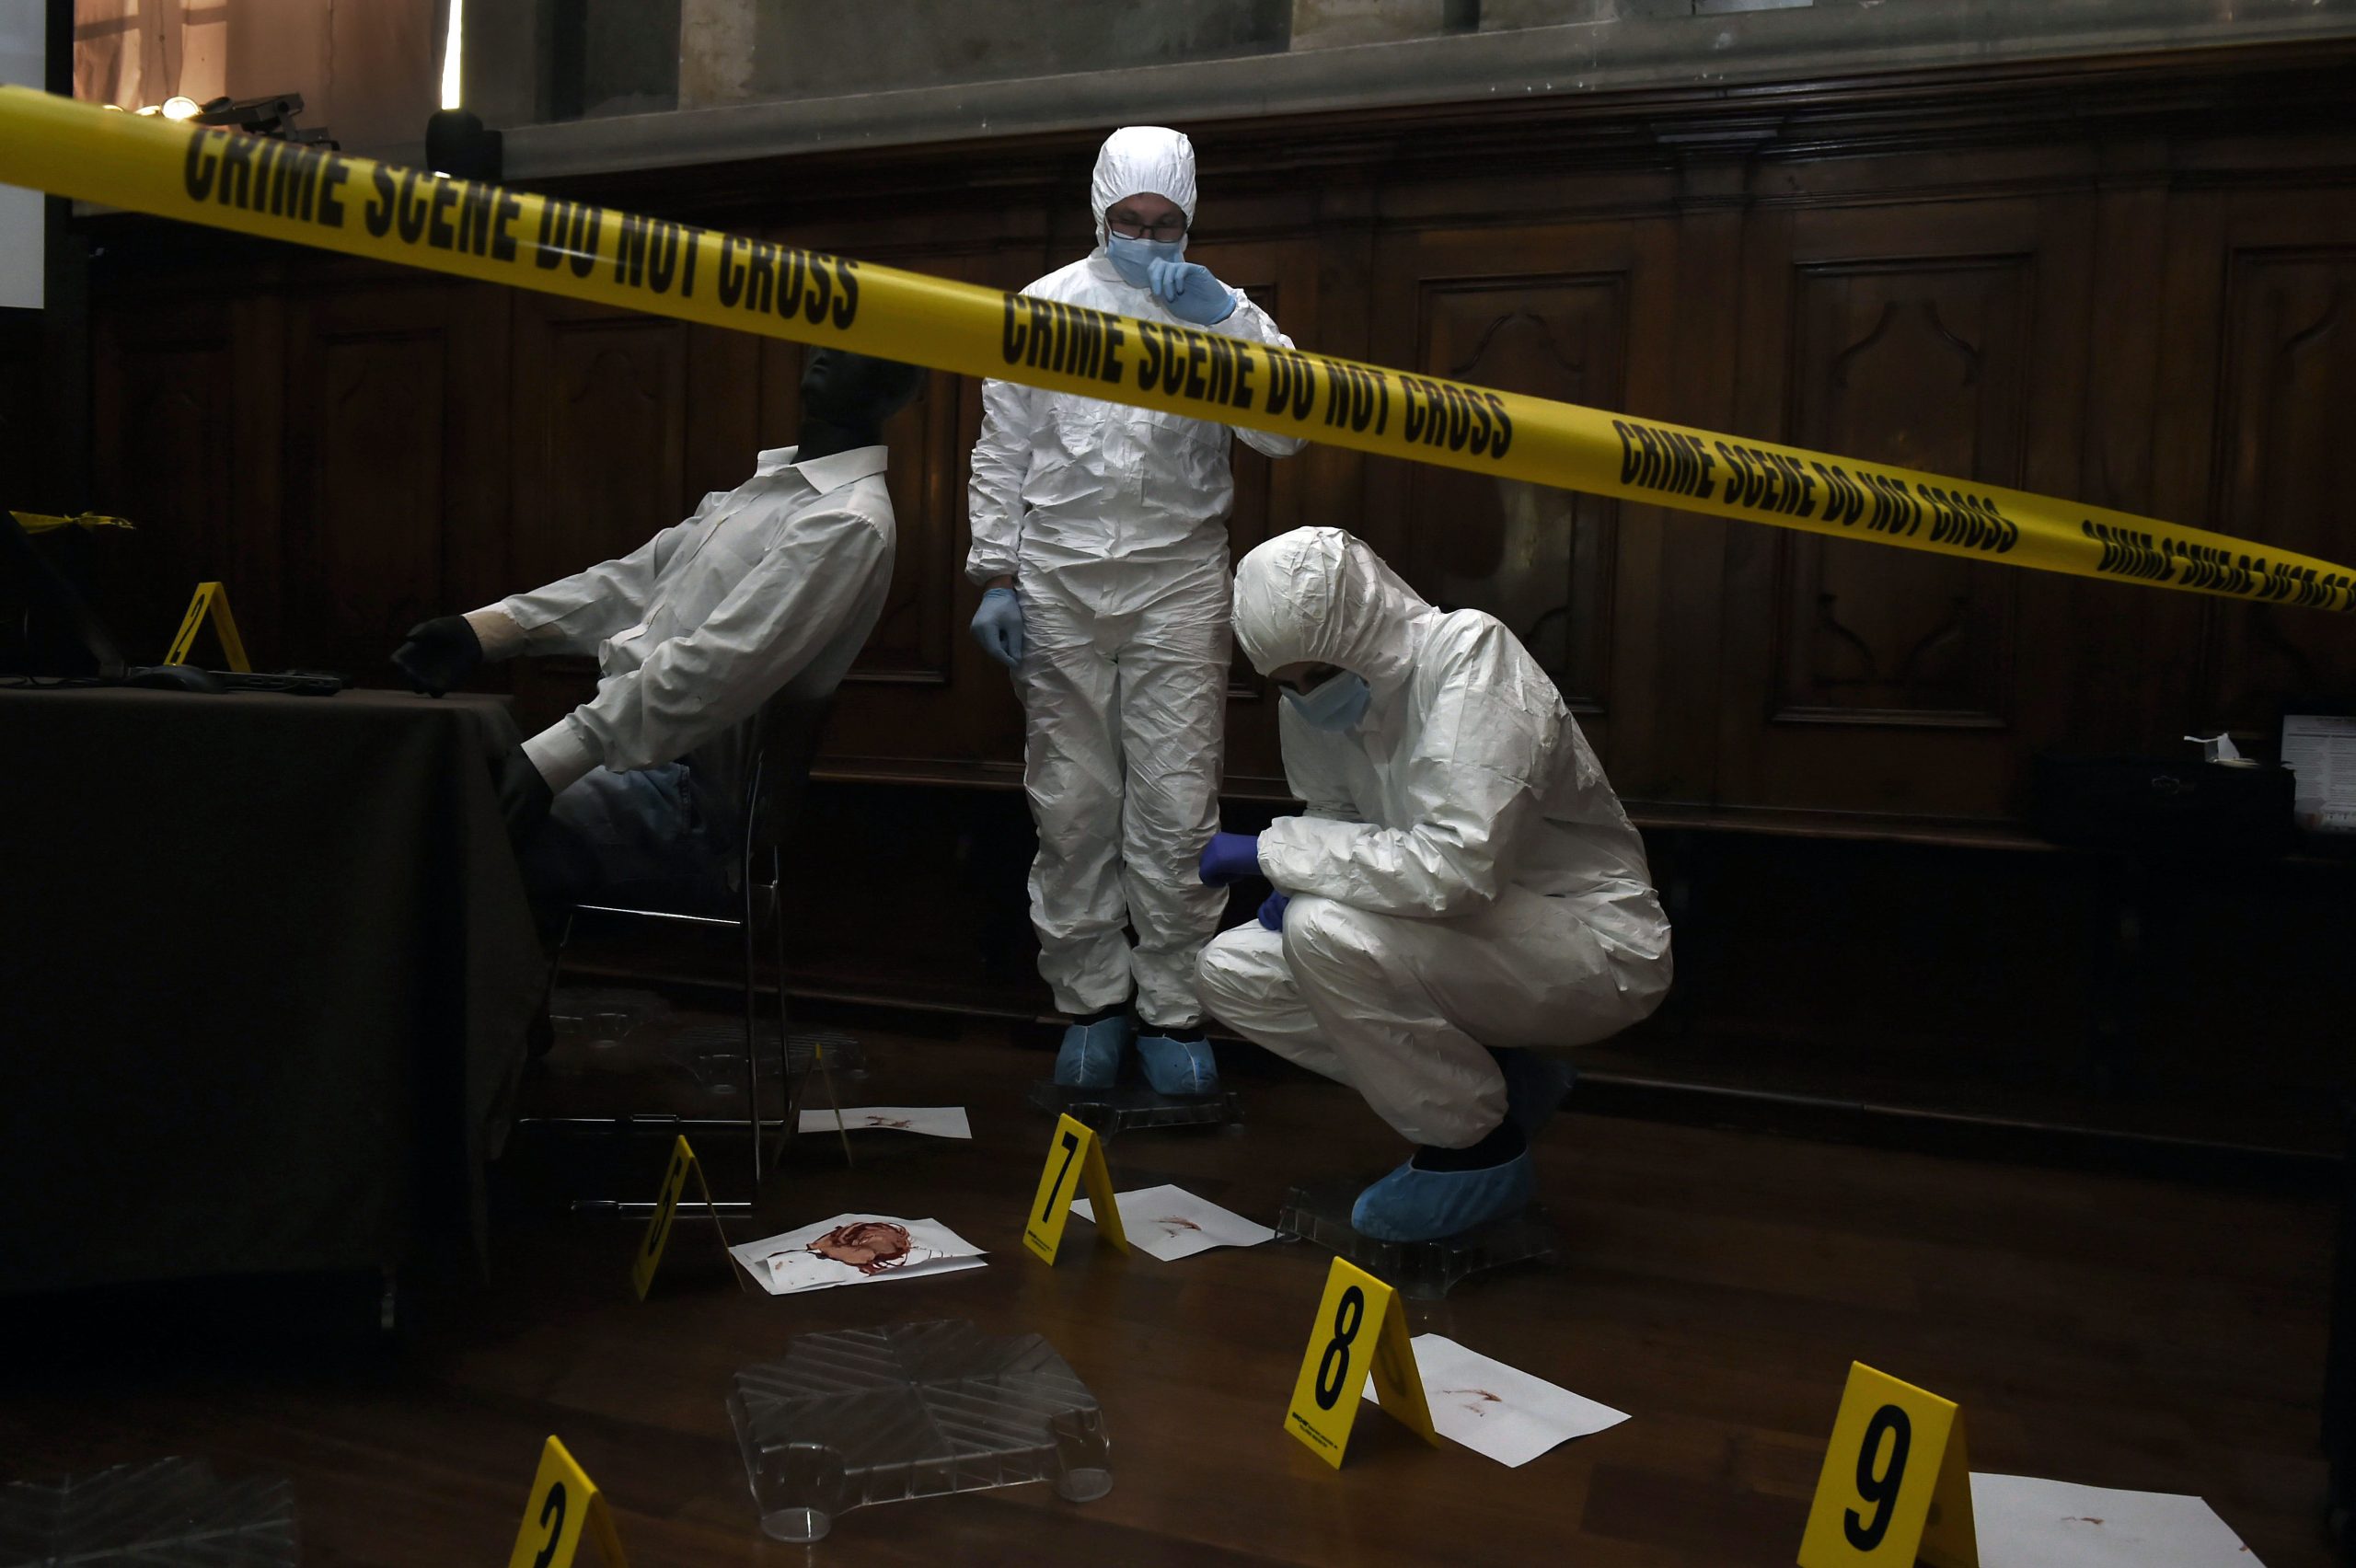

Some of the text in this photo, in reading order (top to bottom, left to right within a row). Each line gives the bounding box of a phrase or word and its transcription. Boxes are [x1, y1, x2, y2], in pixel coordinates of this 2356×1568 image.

[187, 128, 859, 329] CRIME SCENE DO NOT CROSS
[1001, 293, 1513, 459] CRIME SCENE DO NOT CROSS
[1612, 420, 2019, 553] CRIME SCENE DO NOT CROSS
[1042, 1131, 1079, 1223] 7
[1316, 1286, 1365, 1410] 8
[1844, 1404, 1911, 1551] 9
